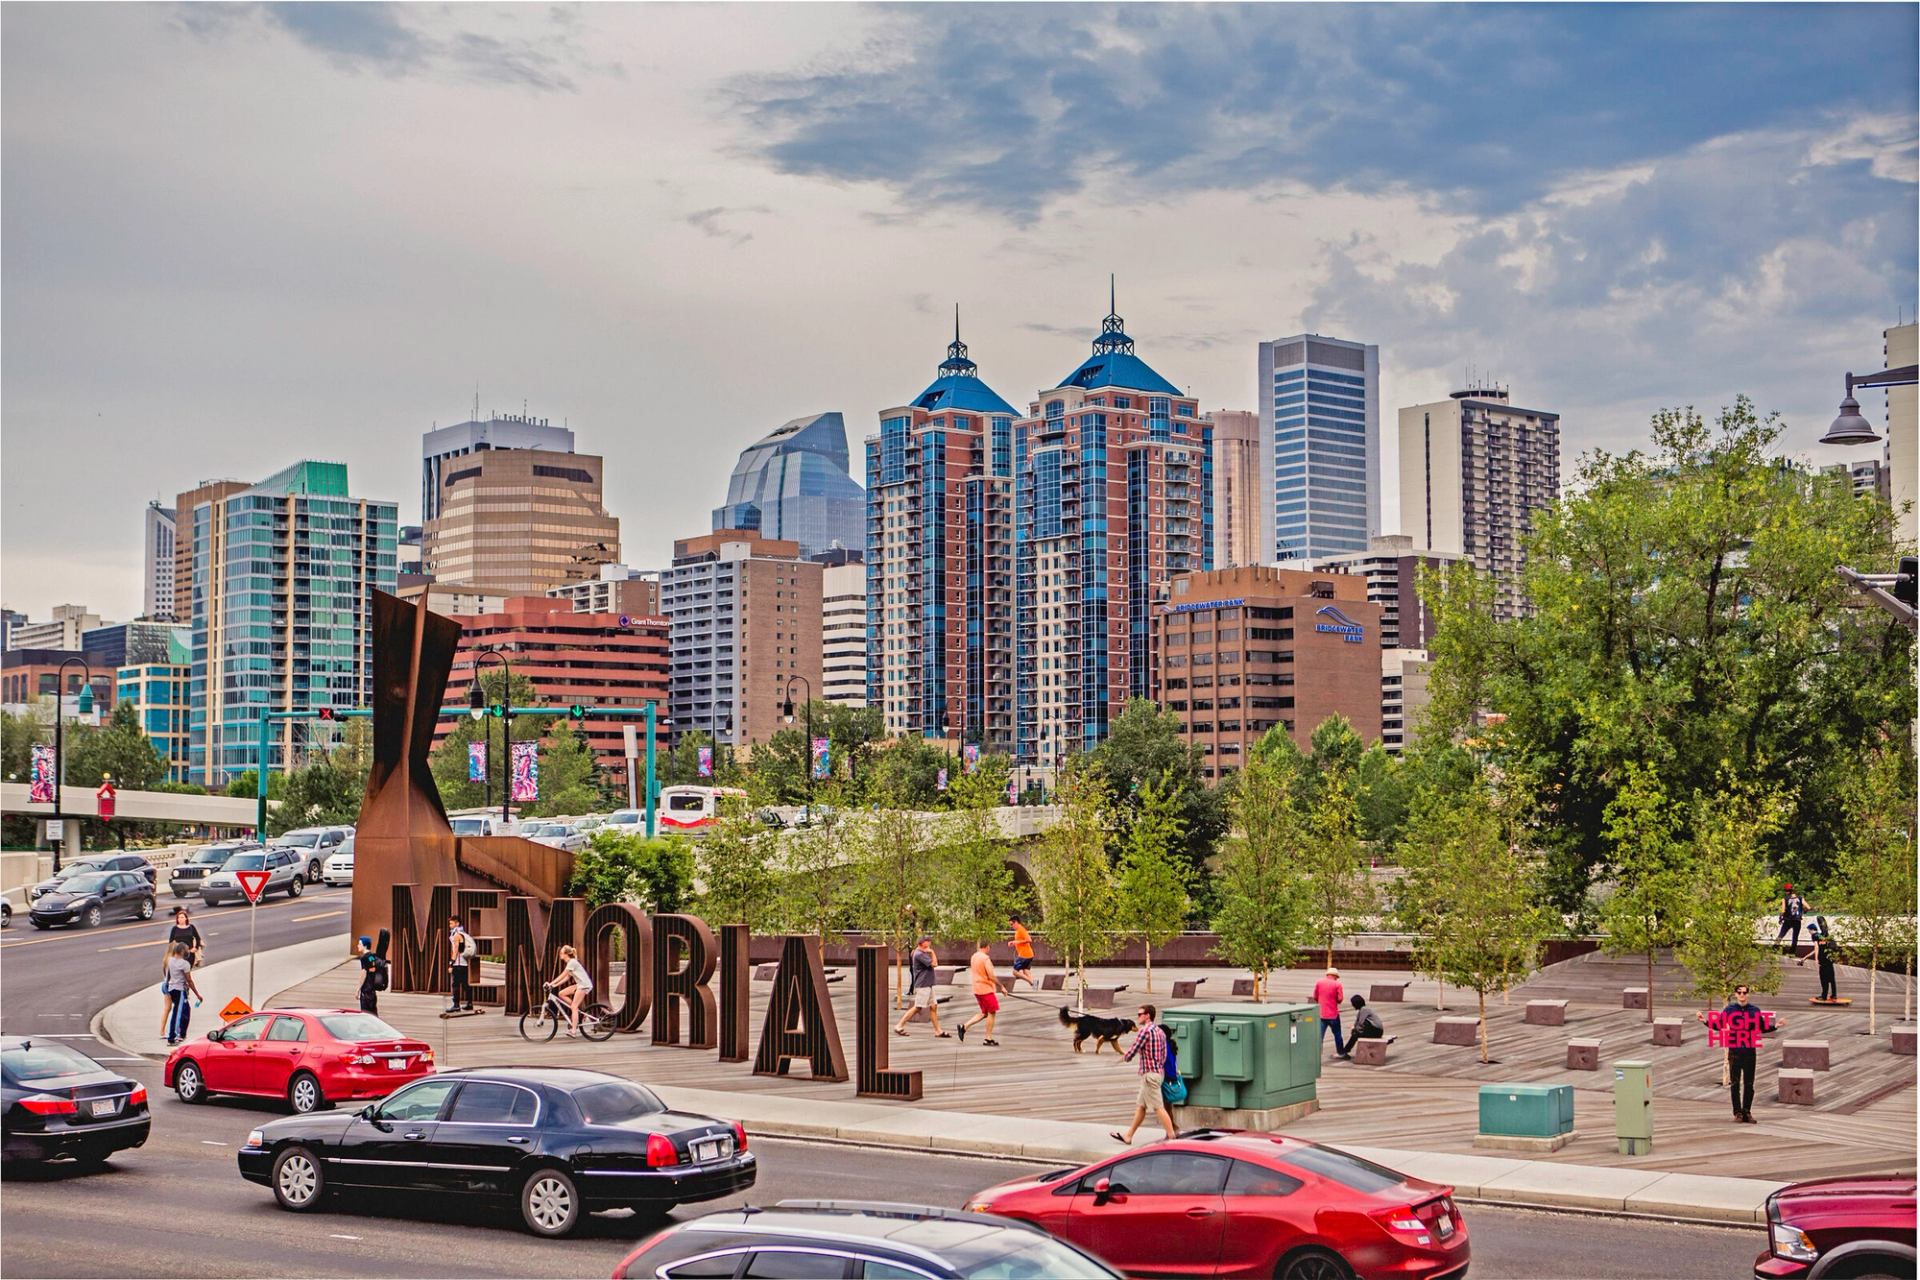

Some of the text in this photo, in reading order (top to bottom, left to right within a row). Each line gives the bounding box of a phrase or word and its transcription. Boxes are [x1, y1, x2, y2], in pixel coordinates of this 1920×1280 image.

[1176, 598, 1245, 613] BRIDGEWATER BANK
[631, 617, 669, 628] Grant Thornton
[1315, 623, 1364, 634] BRIDGEWATER
[1343, 634, 1364, 643] BANK
[391, 883, 923, 1101] MEMORIAL
[1707, 1010, 1776, 1030] RIGHT
[1707, 1029, 1764, 1048] HERE
